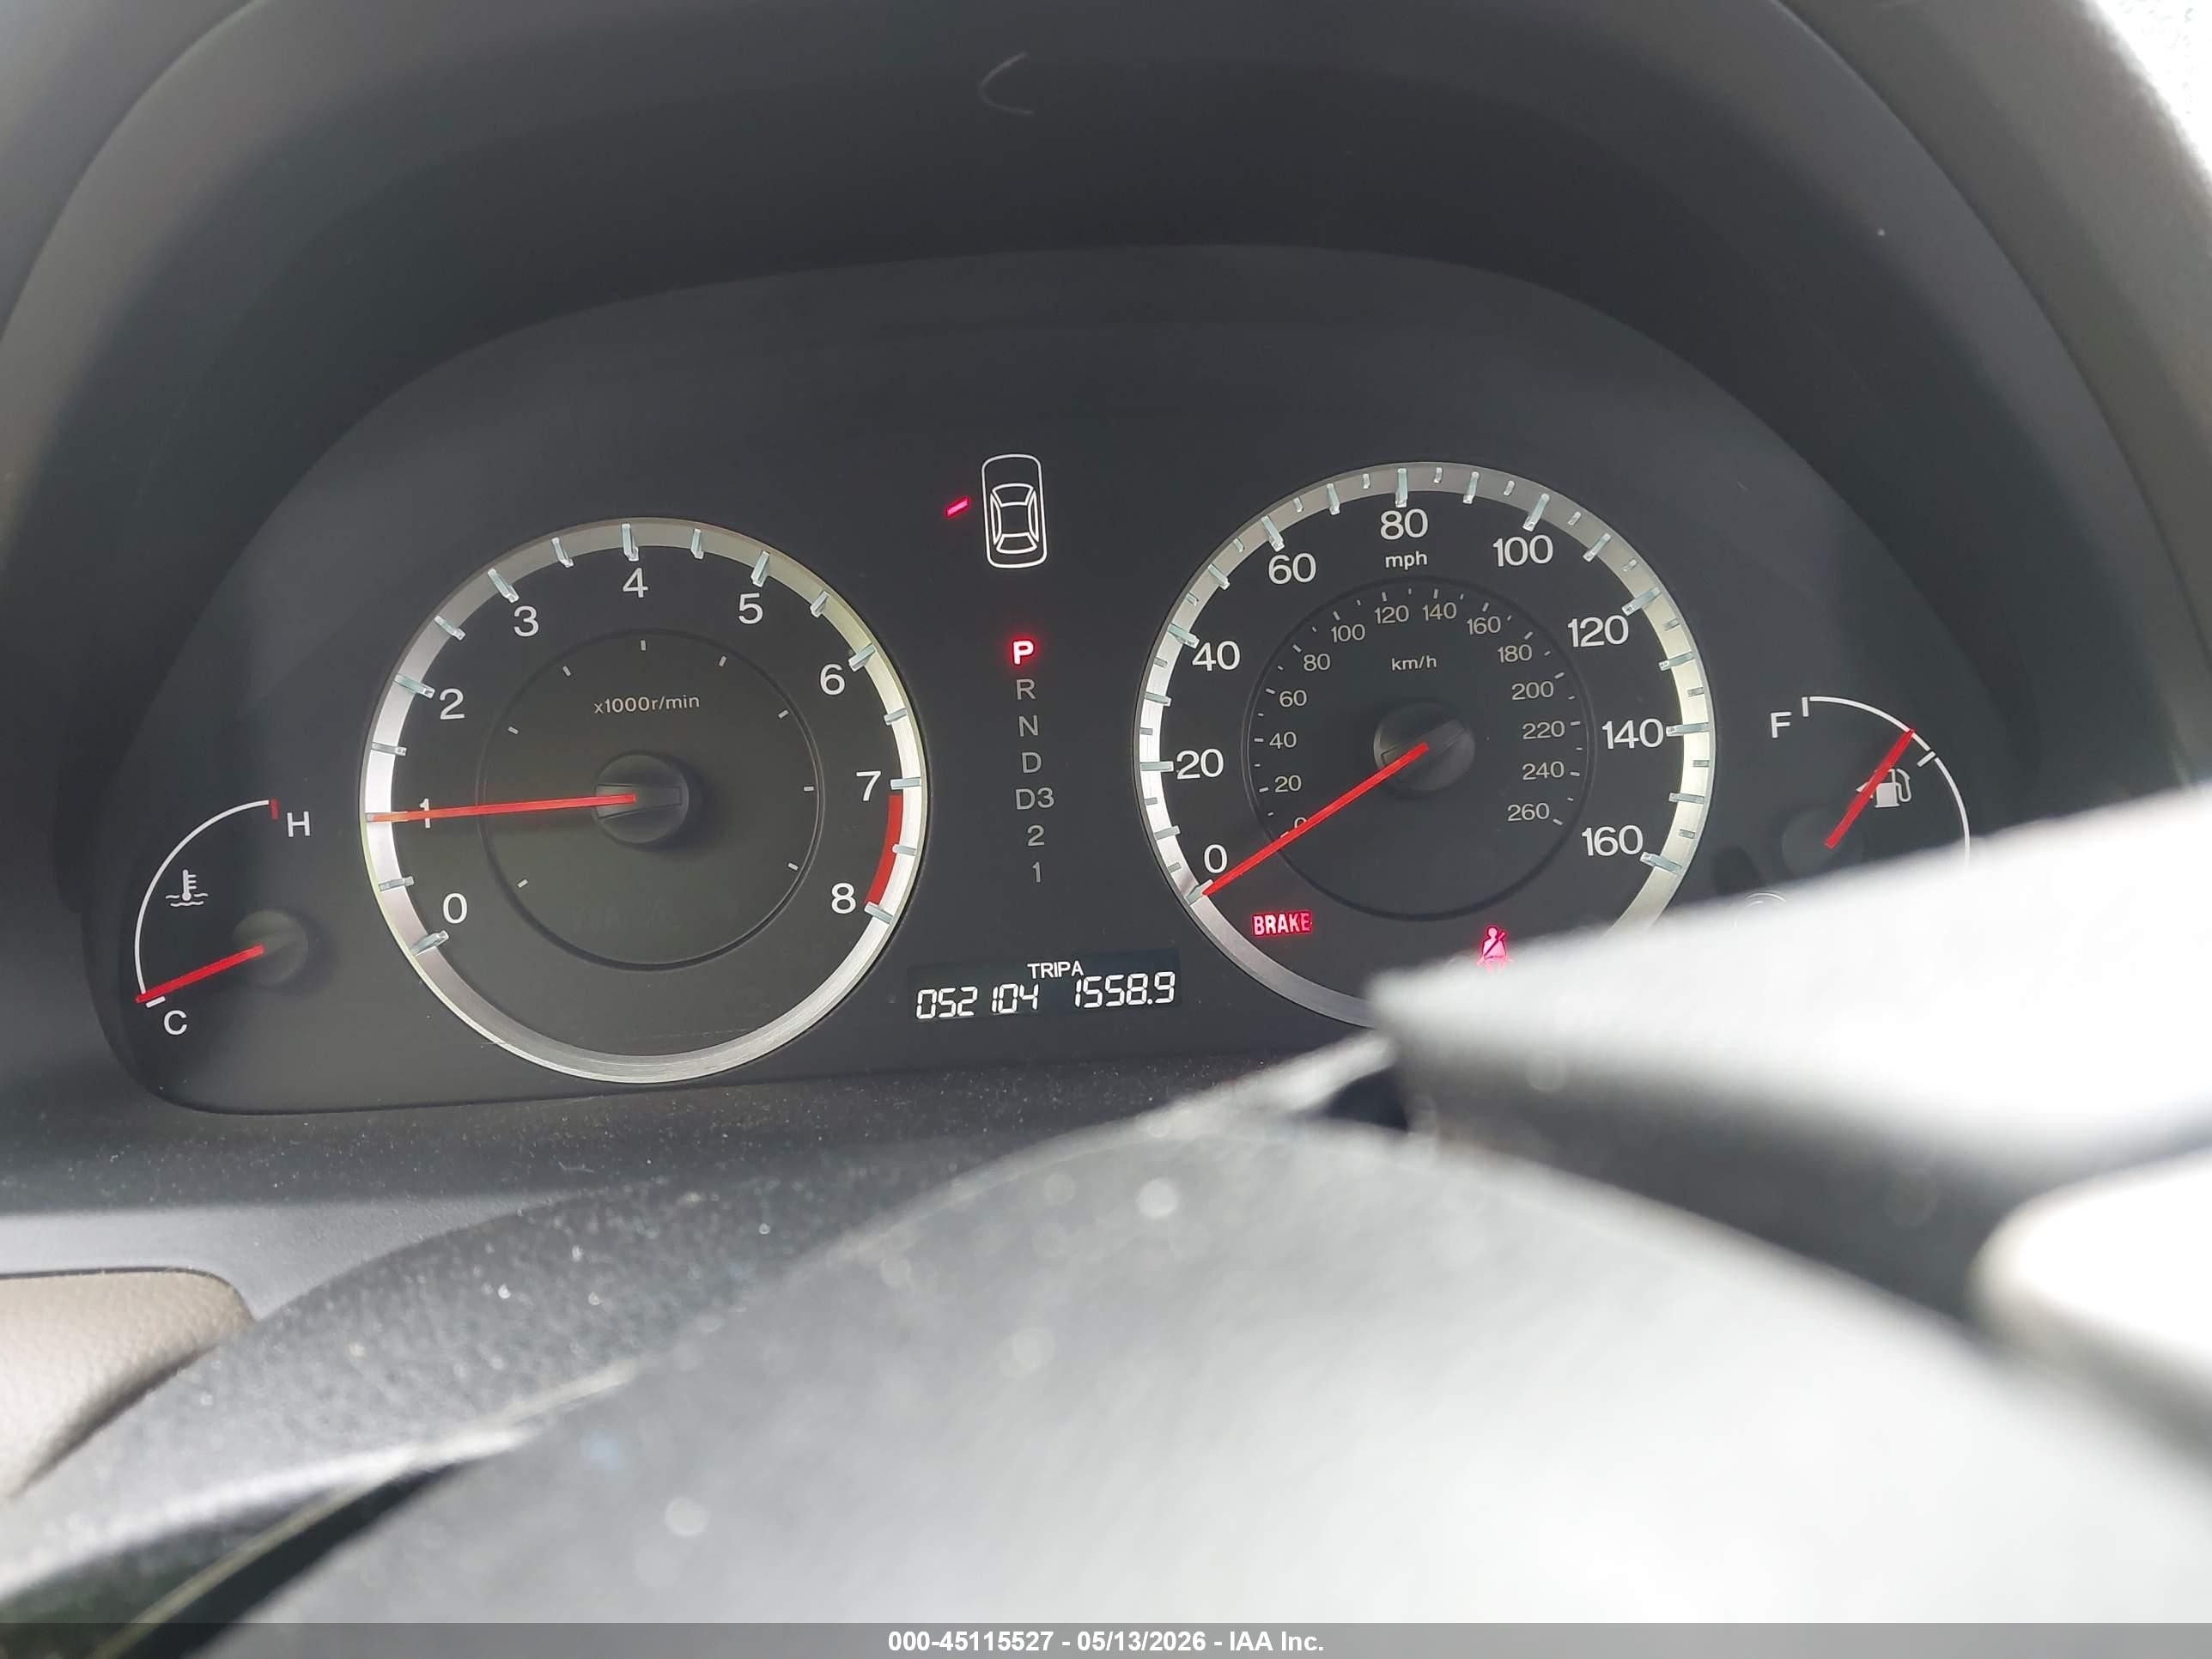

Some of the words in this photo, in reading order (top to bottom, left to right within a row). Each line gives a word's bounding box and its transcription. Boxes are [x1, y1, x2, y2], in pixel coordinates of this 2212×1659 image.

[1380, 509, 1428, 539] 80
[1385, 551, 1428, 569] mph
[1493, 535, 1553, 567] 100
[1268, 554, 1316, 584] 60
[623, 568, 647, 597] 4
[738, 593, 763, 623] 5
[1375, 605, 1409, 623] 120
[1423, 603, 1456, 619] 140
[514, 606, 538, 636] 3
[1332, 624, 1365, 641] 100
[1467, 617, 1501, 635] 160
[1568, 617, 1628, 647] 120
[1013, 641, 1034, 664] P
[1193, 641, 1240, 672] 40
[1304, 653, 1330, 672] 80
[1391, 654, 1437, 671] km/h
[1498, 645, 1532, 662] 180
[819, 665, 845, 695] 6
[1017, 680, 1036, 699] R
[1511, 681, 1554, 700] 200
[440, 690, 465, 719] 2
[593, 694, 699, 714] x1000r/min
[1279, 690, 1307, 708] 60
[1019, 716, 1039, 736] N
[1522, 720, 1565, 738] 220
[1602, 719, 1663, 749] 140
[1771, 712, 1792, 738] F
[1269, 732, 1297, 749] 40
[1023, 753, 1042, 772] D
[1176, 750, 1223, 779] 20
[1522, 762, 1564, 780] 240
[856, 772, 880, 801] 7
[1274, 775, 1302, 793] 20
[1016, 788, 1054, 809] D3
[419, 798, 430, 829] 1
[1508, 803, 1549, 821] 260
[287, 811, 311, 837] H
[1027, 826, 1045, 846] 2
[1582, 826, 1642, 855] 160
[1204, 846, 1227, 872] 0
[1032, 862, 1042, 882] 1
[443, 894, 467, 923] 0
[831, 884, 854, 913] 8
[1254, 912, 1310, 935] BRAKE
[1074, 972, 1175, 1007] 1558.9
[164, 1011, 187, 1035] C
